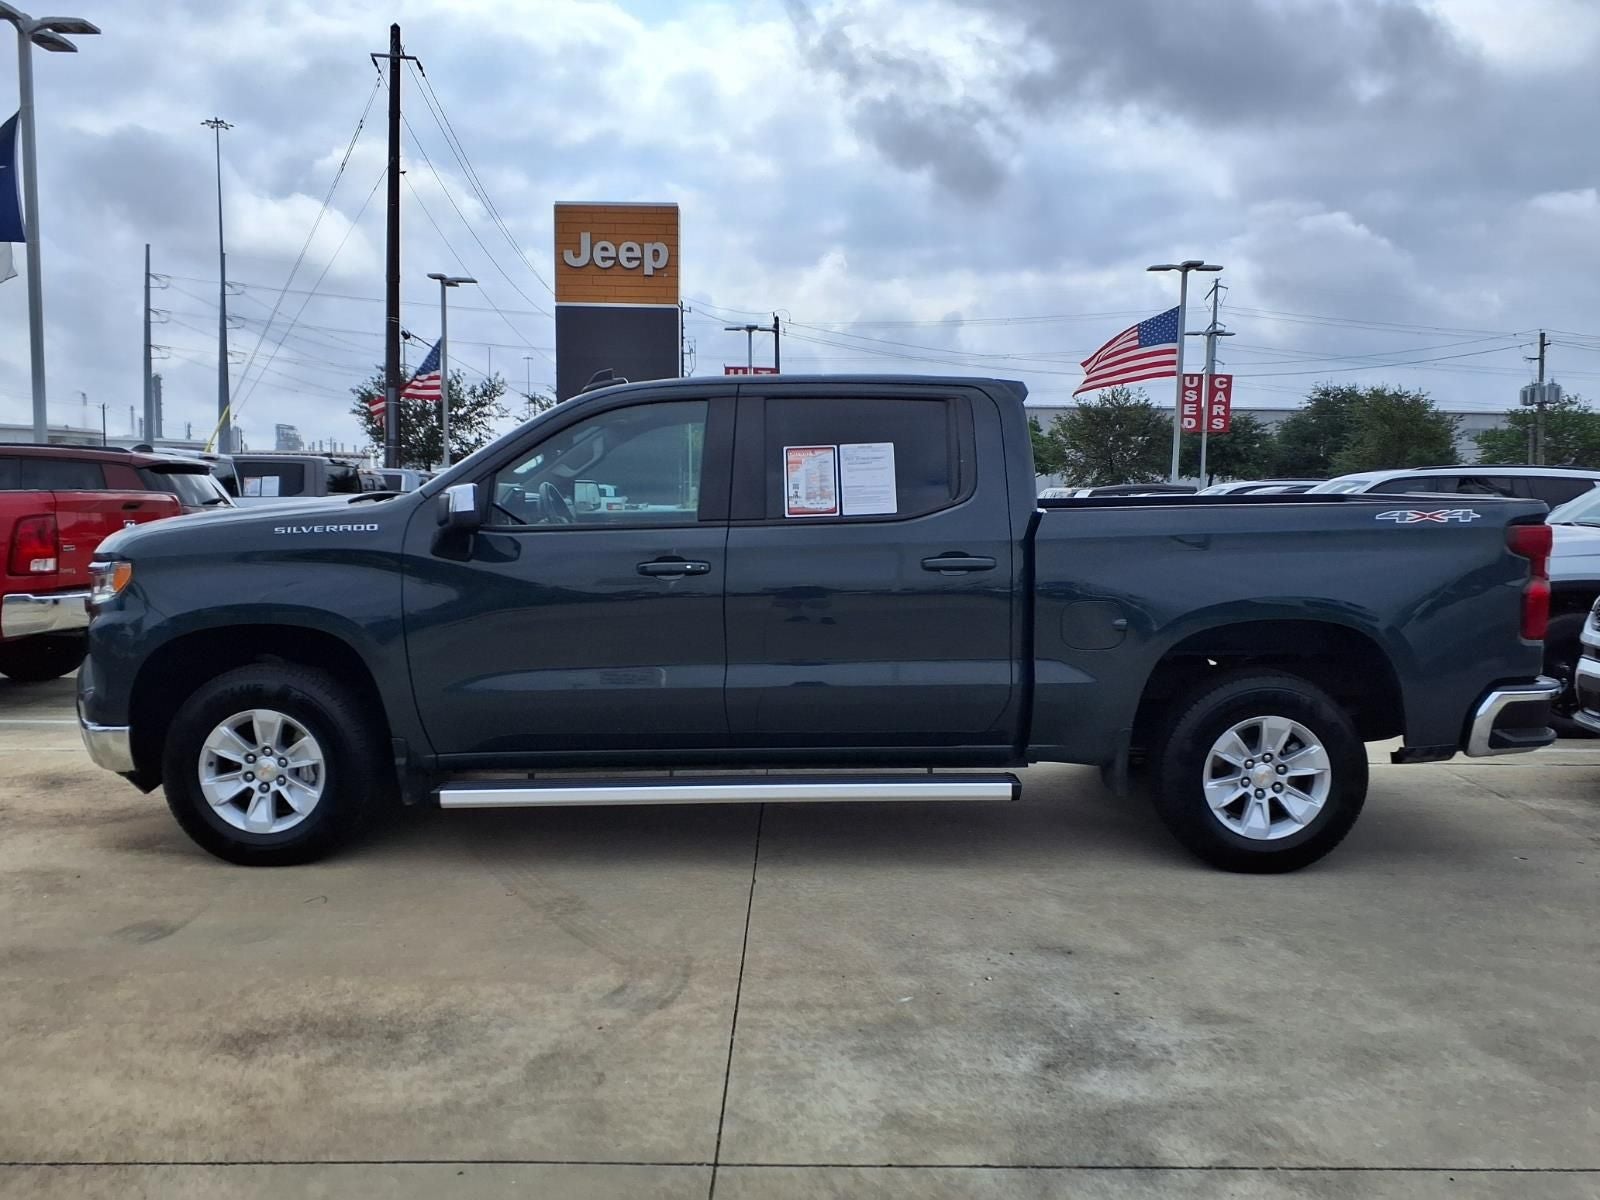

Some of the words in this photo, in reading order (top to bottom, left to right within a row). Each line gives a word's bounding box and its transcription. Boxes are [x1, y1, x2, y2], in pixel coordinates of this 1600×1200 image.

[563, 231, 669, 276] Jeep
[1183, 376, 1199, 429] USED
[1211, 377, 1228, 430] CARS
[273, 523, 379, 535] SILVERADO
